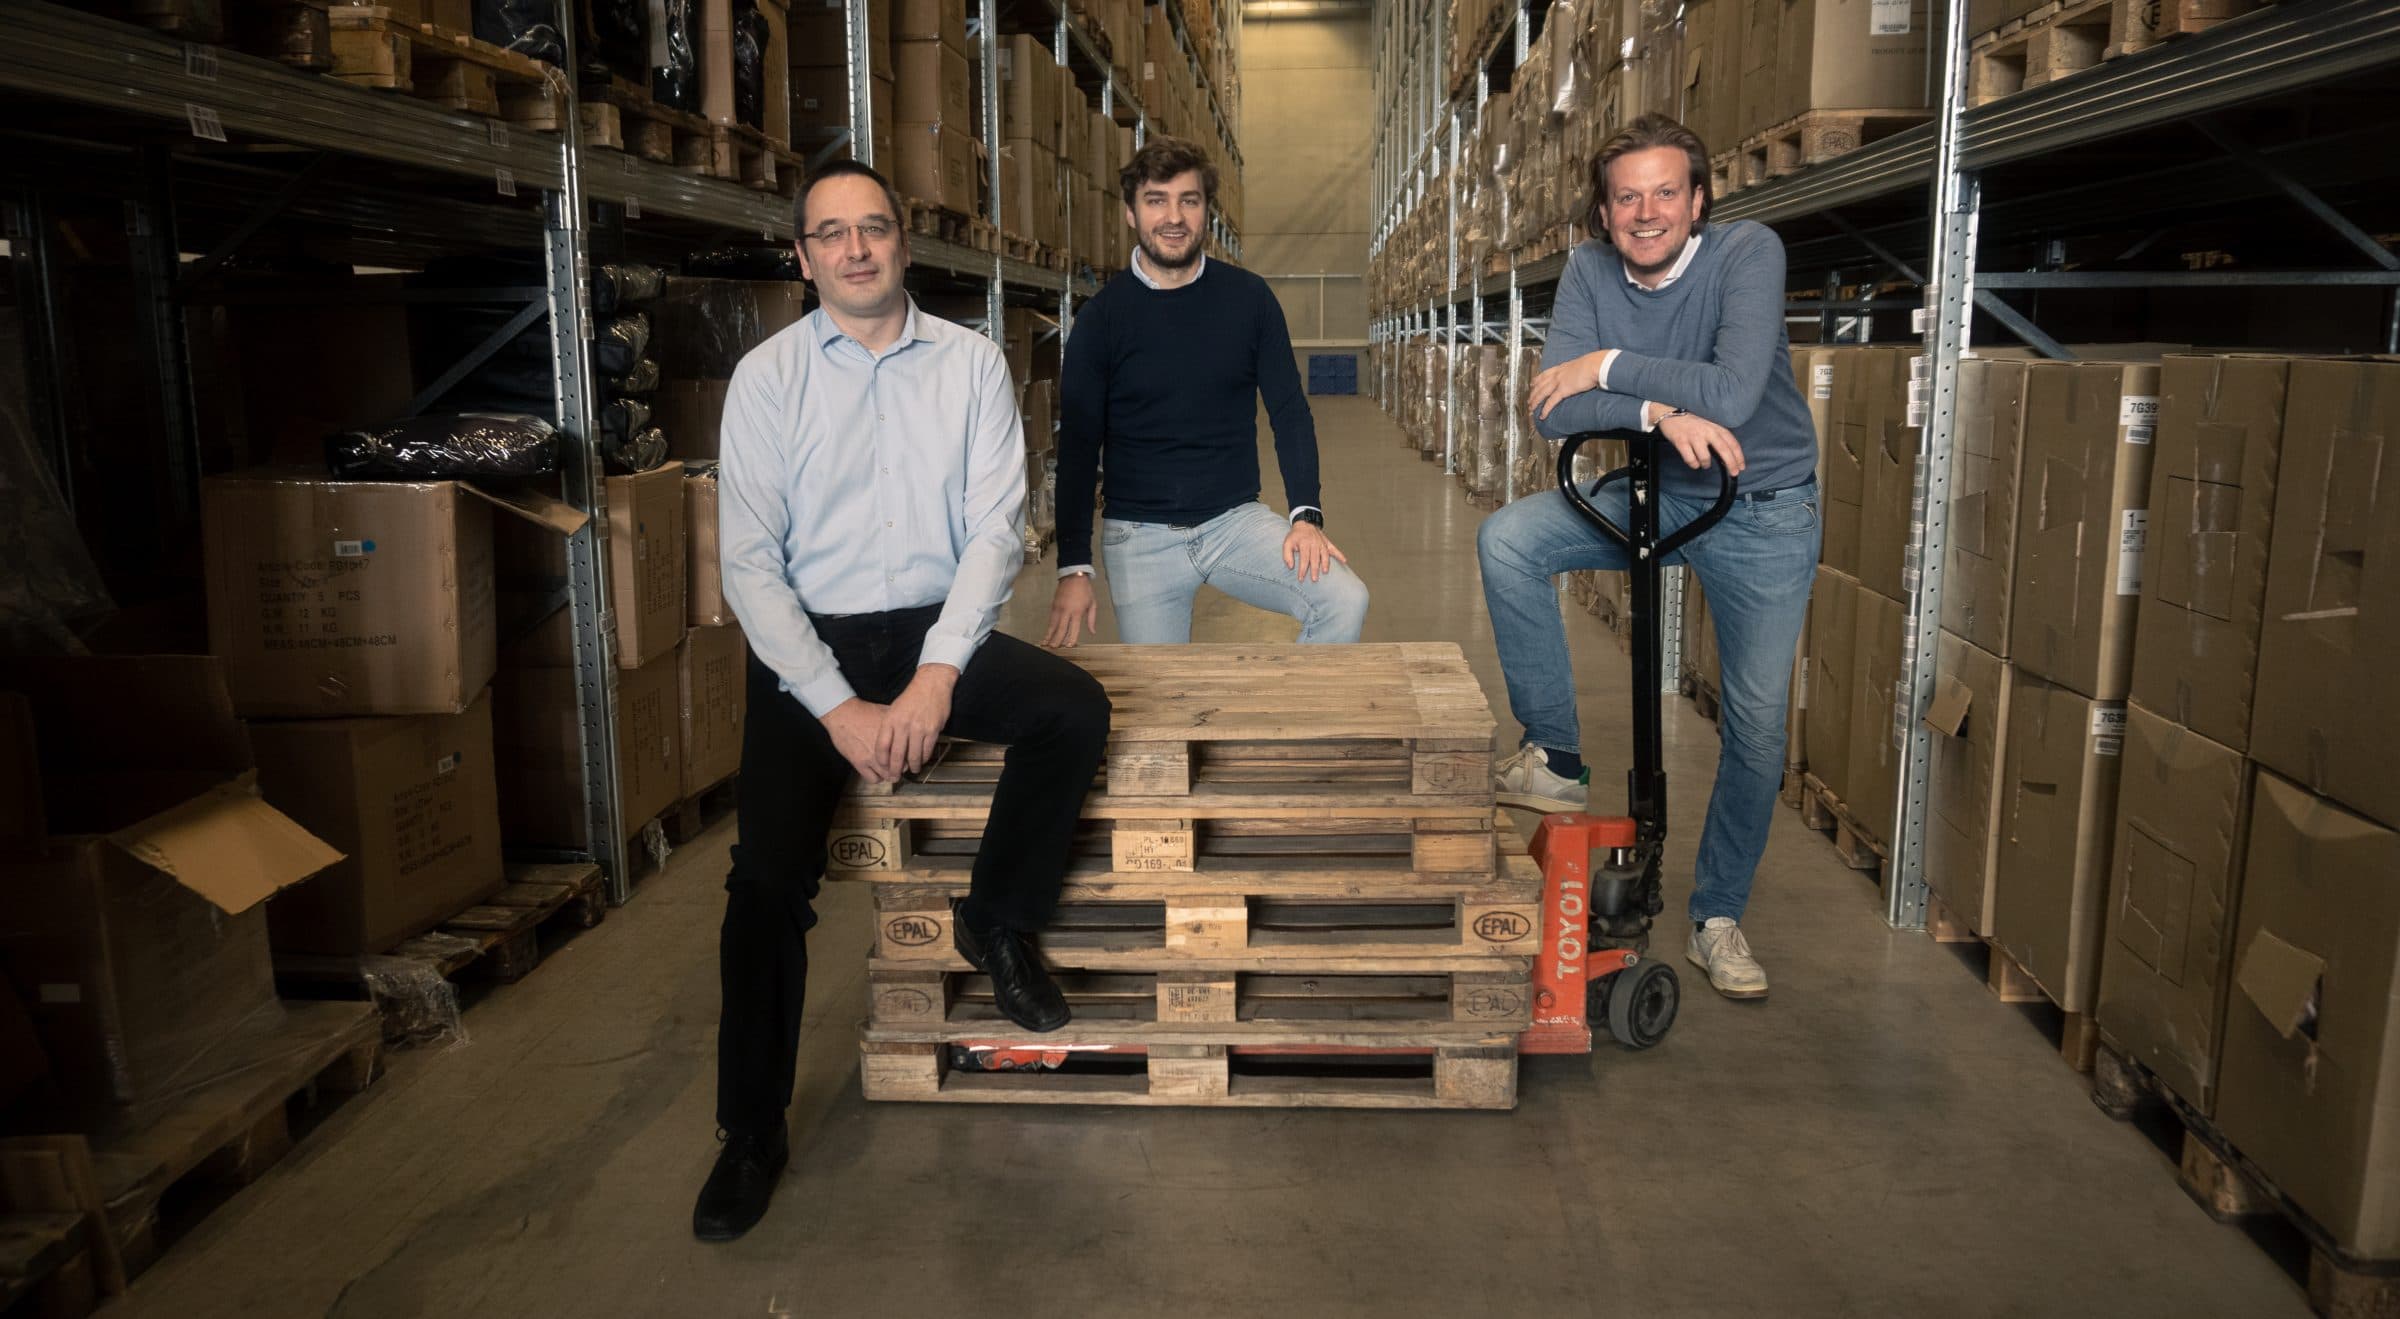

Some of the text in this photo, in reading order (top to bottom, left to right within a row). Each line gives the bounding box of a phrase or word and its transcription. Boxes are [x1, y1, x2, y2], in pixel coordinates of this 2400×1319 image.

[838, 842, 879, 861] EPAL
[893, 922, 934, 940] EPAL
[1481, 918, 1522, 936] EPAL
